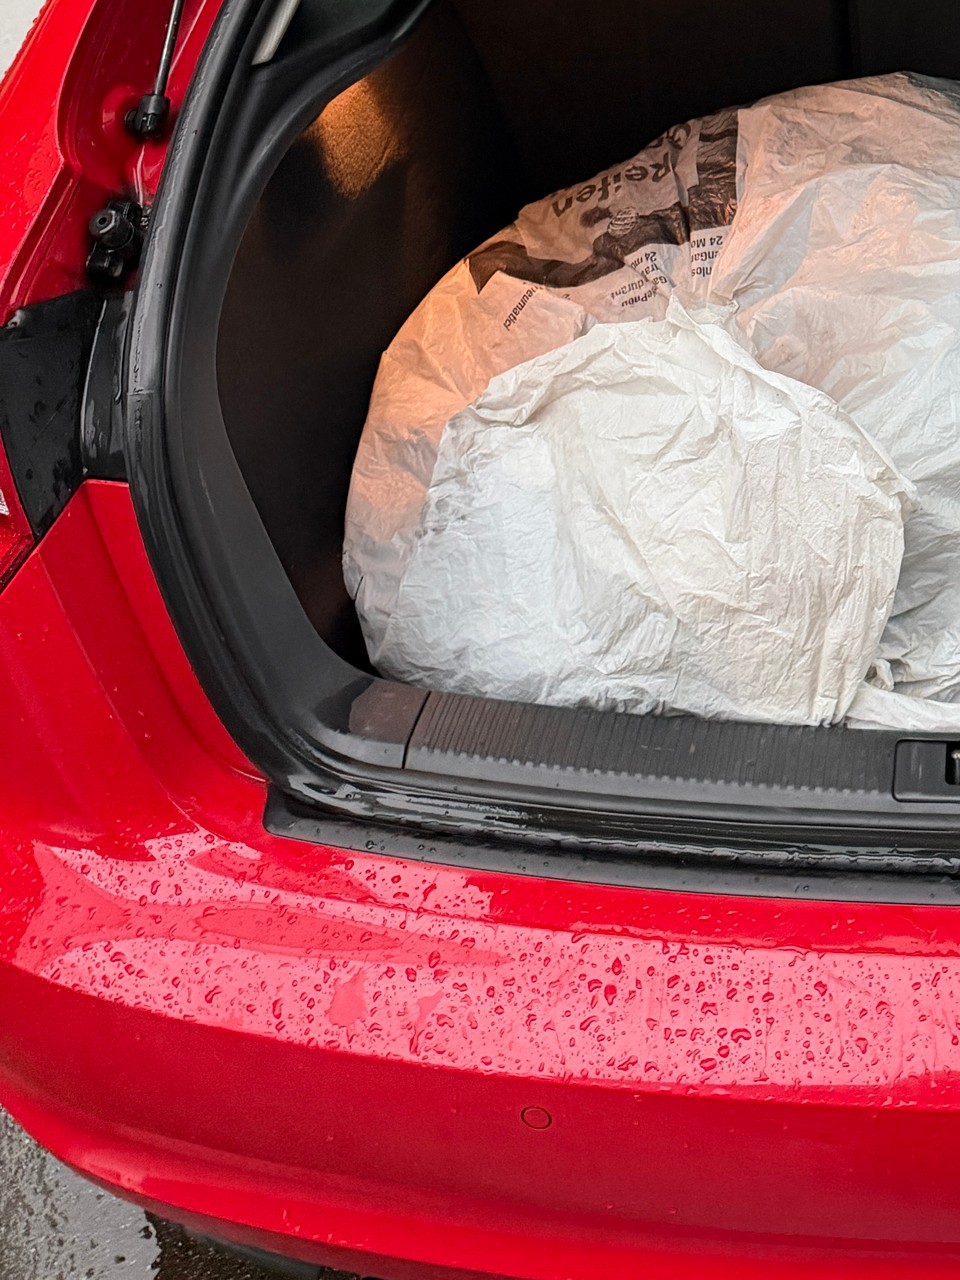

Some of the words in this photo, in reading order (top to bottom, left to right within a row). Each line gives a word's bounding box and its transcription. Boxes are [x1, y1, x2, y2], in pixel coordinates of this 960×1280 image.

[551, 151, 672, 218] Reifen
[709, 235, 724, 246] 24
[644, 251, 657, 262] 24
[503, 285, 543, 331] neumatici
